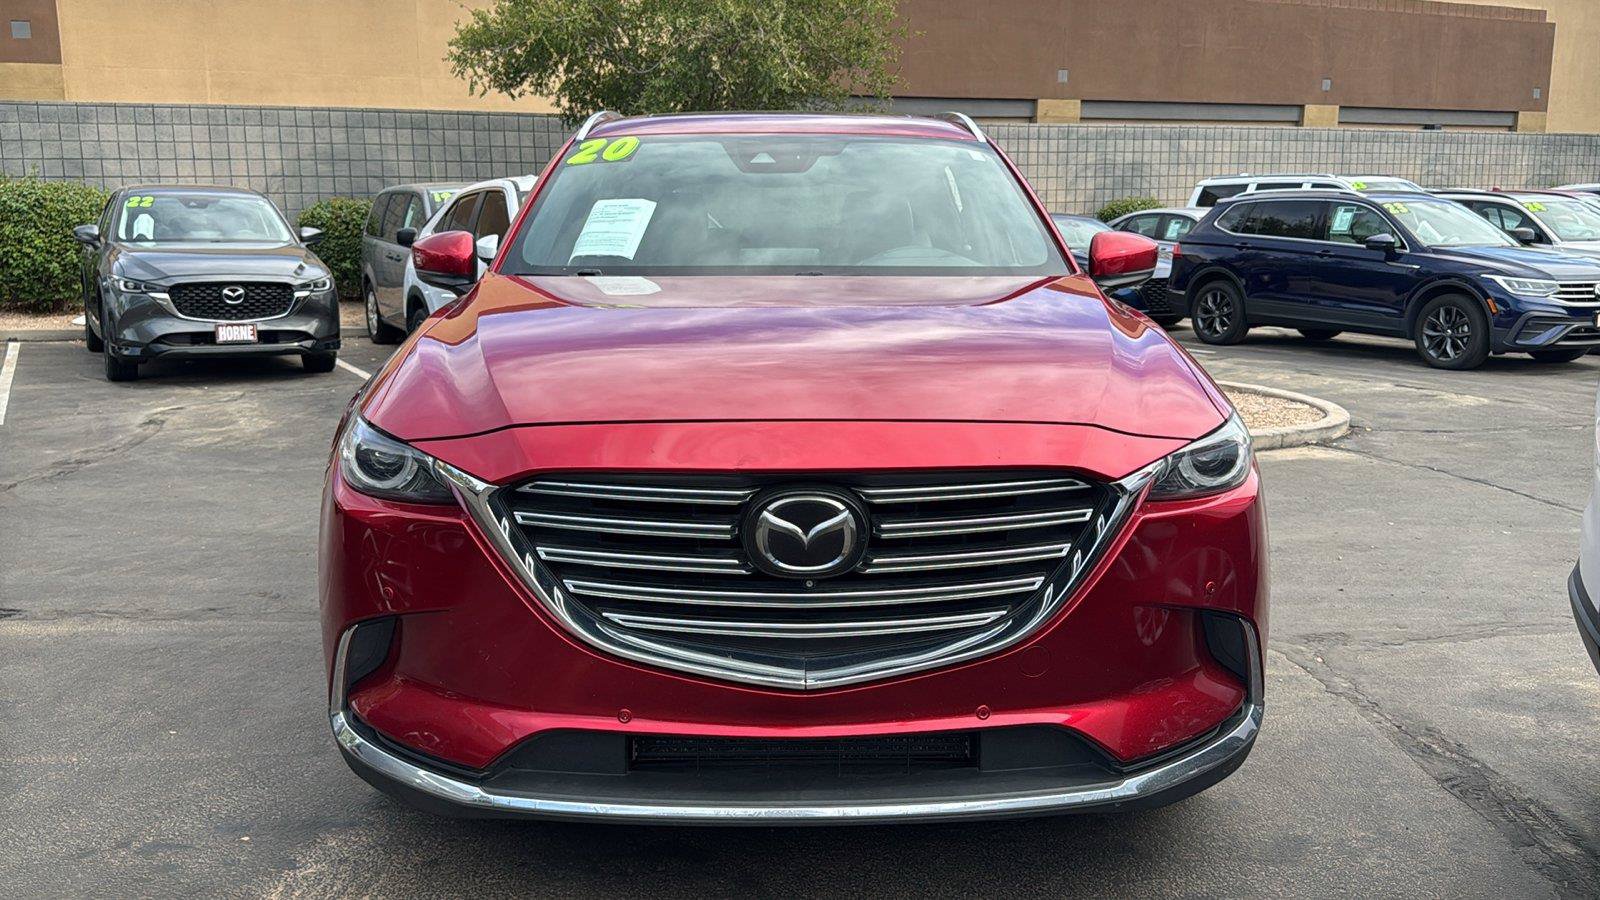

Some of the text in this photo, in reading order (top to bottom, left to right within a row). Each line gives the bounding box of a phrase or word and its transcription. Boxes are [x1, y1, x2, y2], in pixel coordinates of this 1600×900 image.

[566, 136, 639, 165] 20
[127, 196, 154, 208] 22
[217, 325, 255, 341] HORNE
